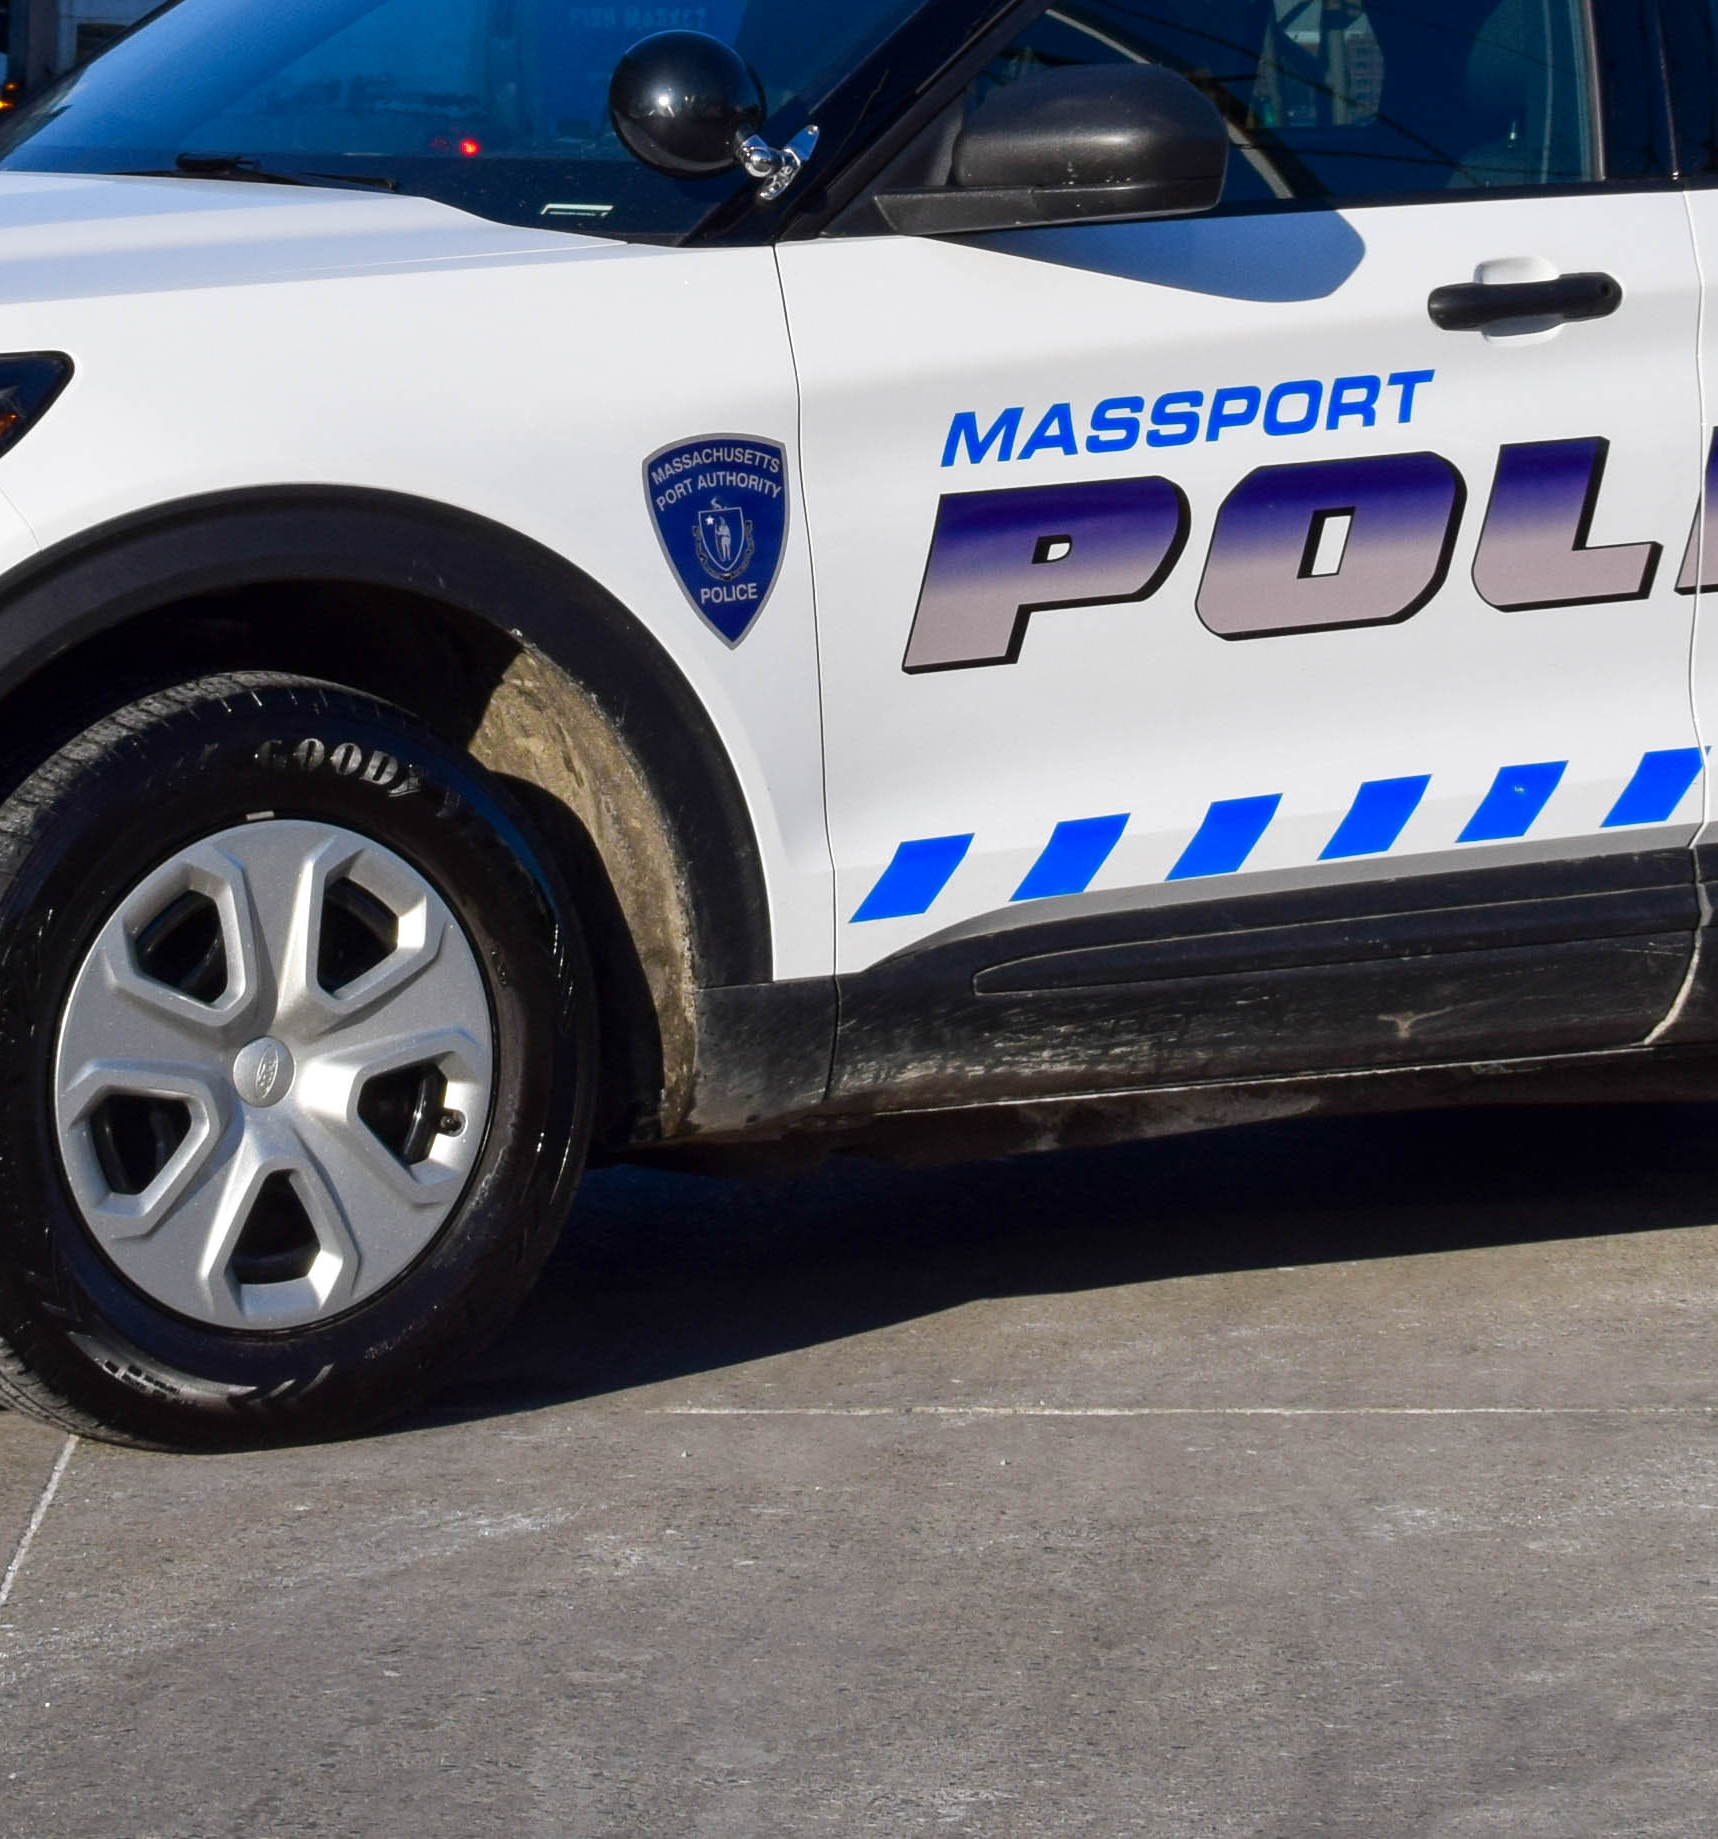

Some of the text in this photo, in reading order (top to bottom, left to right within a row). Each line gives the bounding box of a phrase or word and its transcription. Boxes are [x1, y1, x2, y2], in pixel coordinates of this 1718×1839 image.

[940, 369, 1435, 466] MASSPORT
[651, 447, 781, 485] MASSACHUSETTS
[656, 471, 782, 512] PORT AUTHORITY
[700, 583, 758, 604] POLICE
